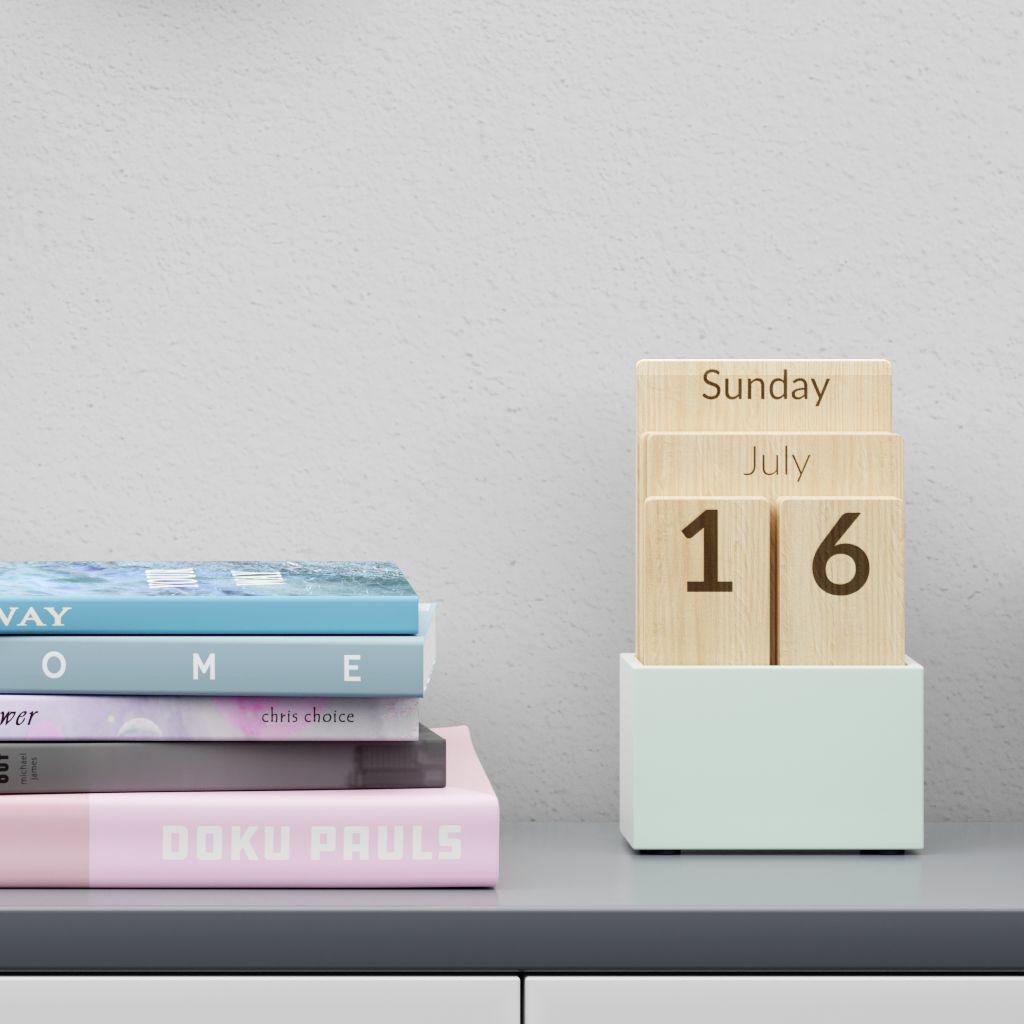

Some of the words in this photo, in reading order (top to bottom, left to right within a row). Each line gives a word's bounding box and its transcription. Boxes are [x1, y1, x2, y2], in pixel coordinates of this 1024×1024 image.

[701, 368, 831, 407] Sunday
[743, 445, 811, 482] July
[261, 707, 298, 724] chris
[304, 707, 355, 724] choice
[19, 752, 28, 785] michael
[162, 824, 292, 861] DOKU
[311, 824, 463, 861] PAULS
